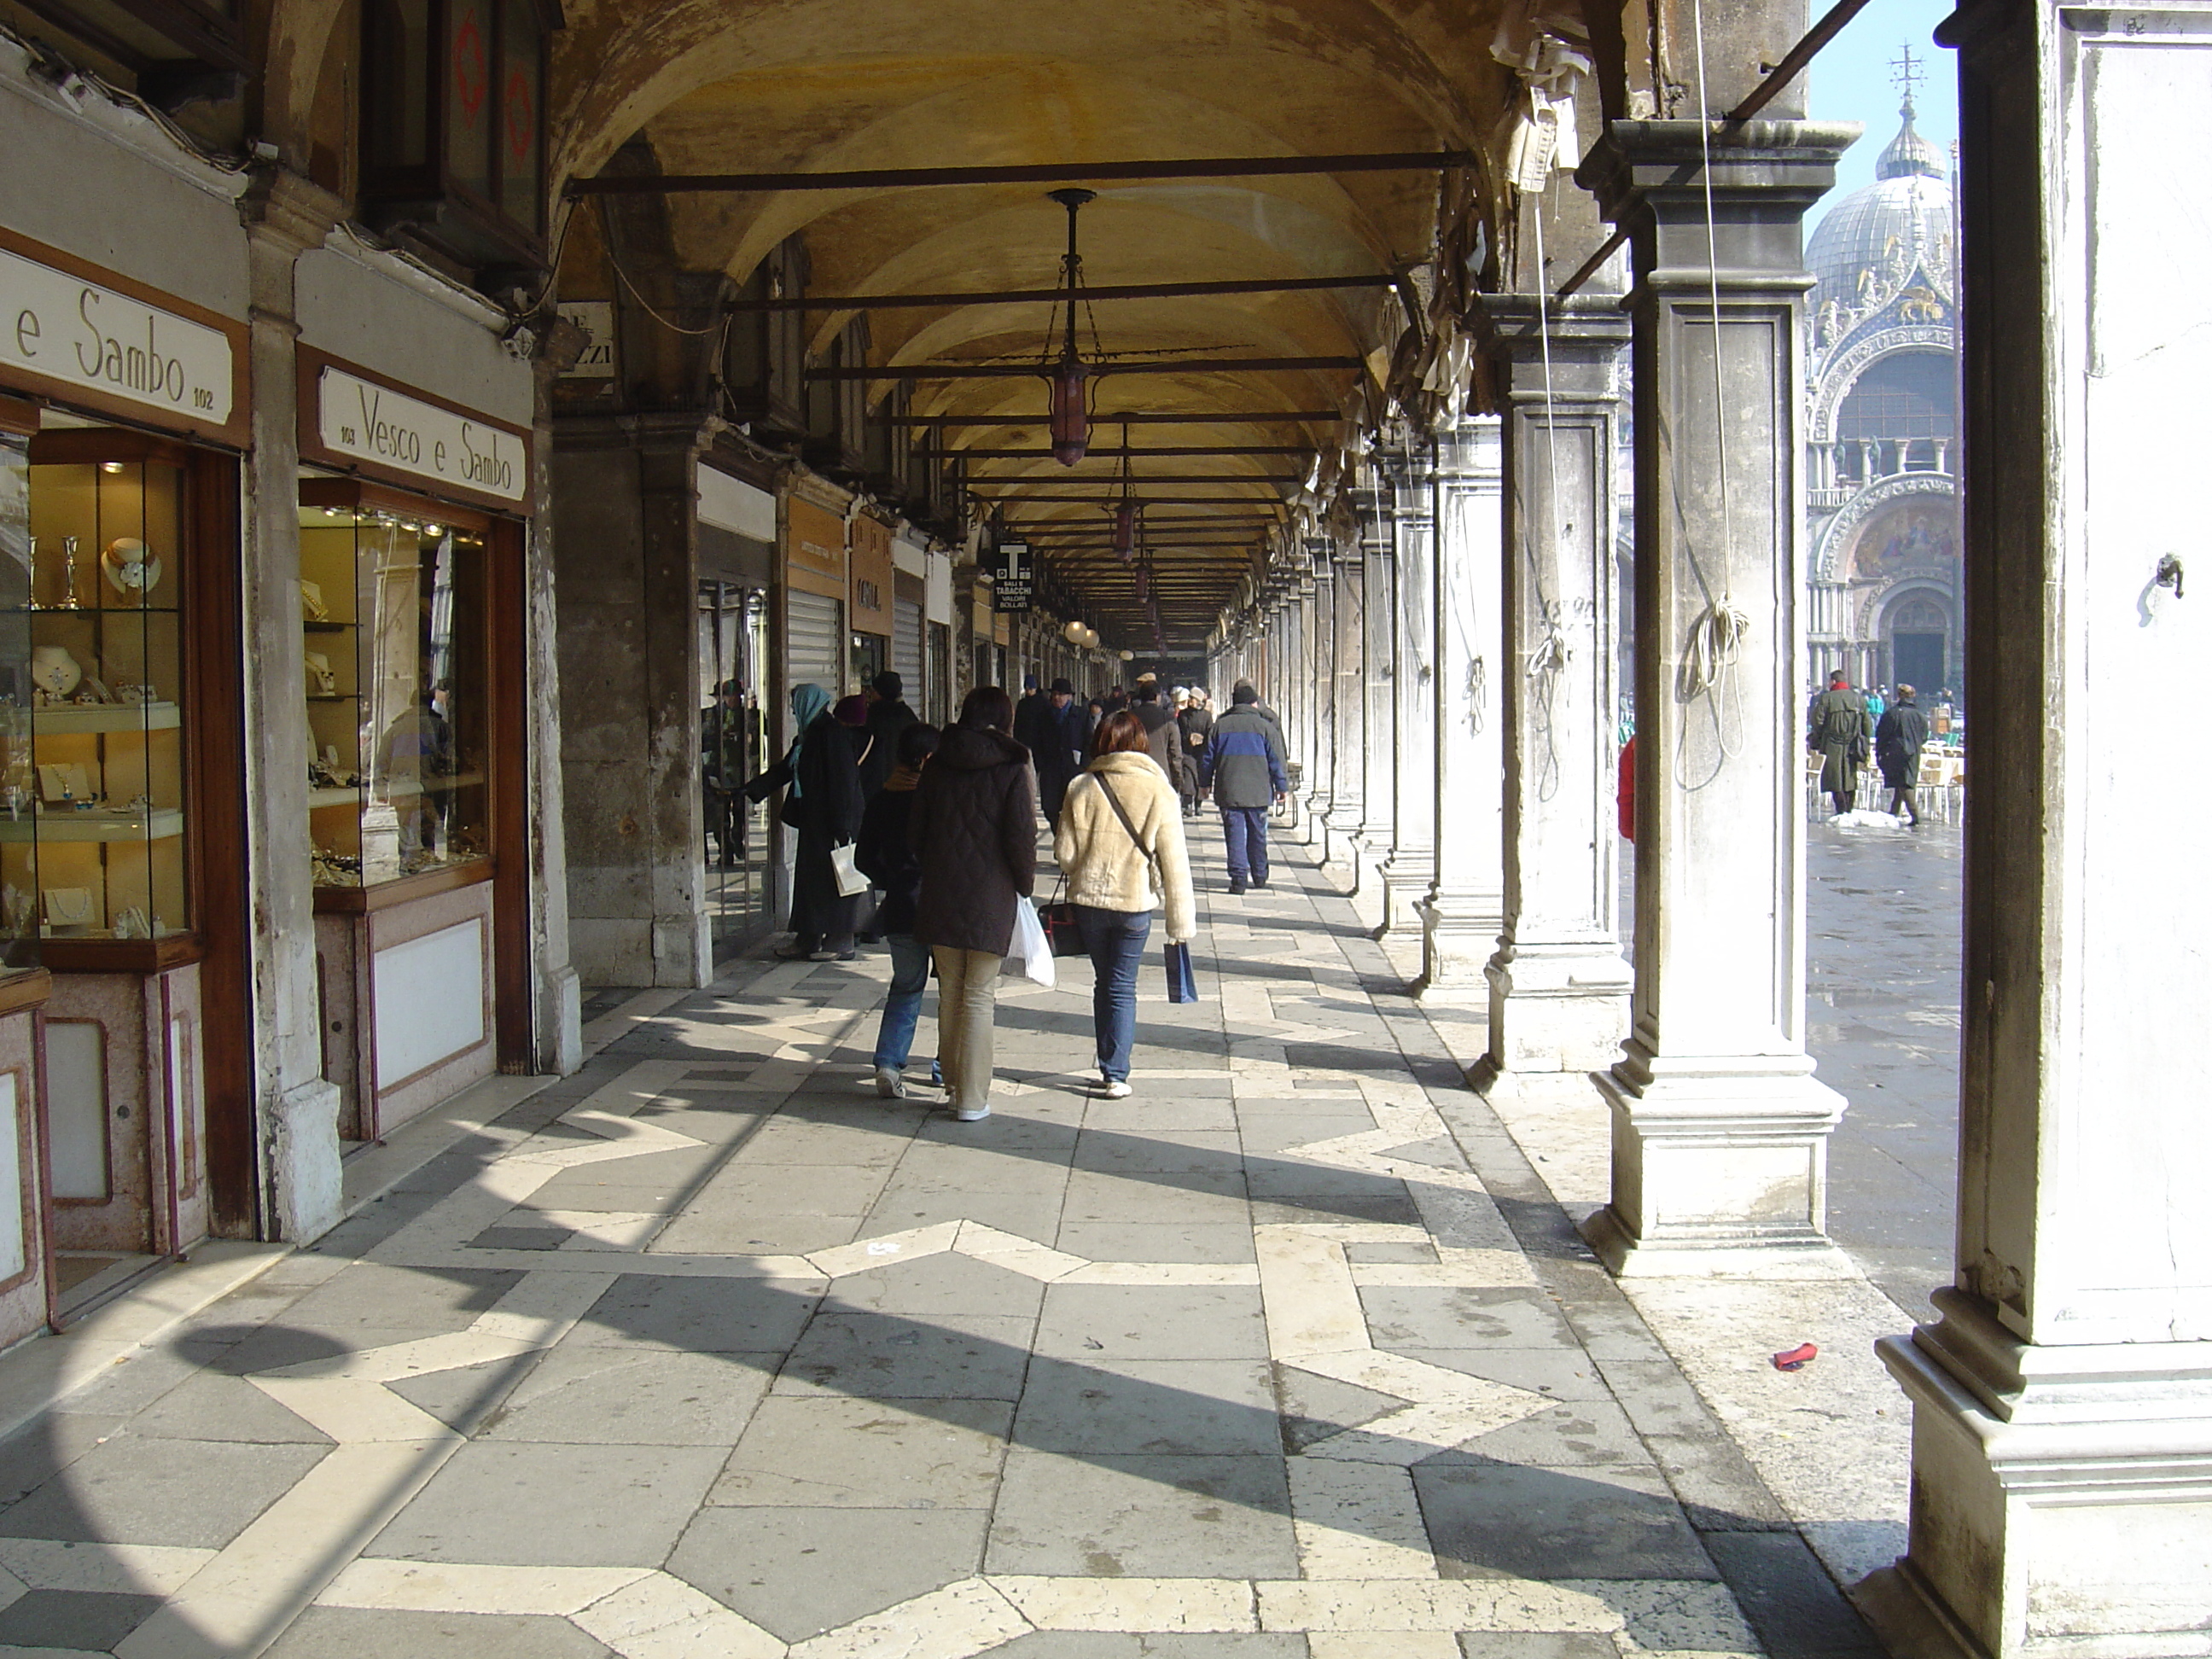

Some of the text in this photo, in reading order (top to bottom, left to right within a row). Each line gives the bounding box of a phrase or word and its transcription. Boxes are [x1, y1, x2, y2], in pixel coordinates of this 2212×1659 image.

[16, 288, 213, 410] e Sambo 102
[358, 384, 420, 463] Vesco
[434, 440, 445, 472] e
[461, 422, 511, 490] Sambo
[1000, 545, 1027, 579] T
